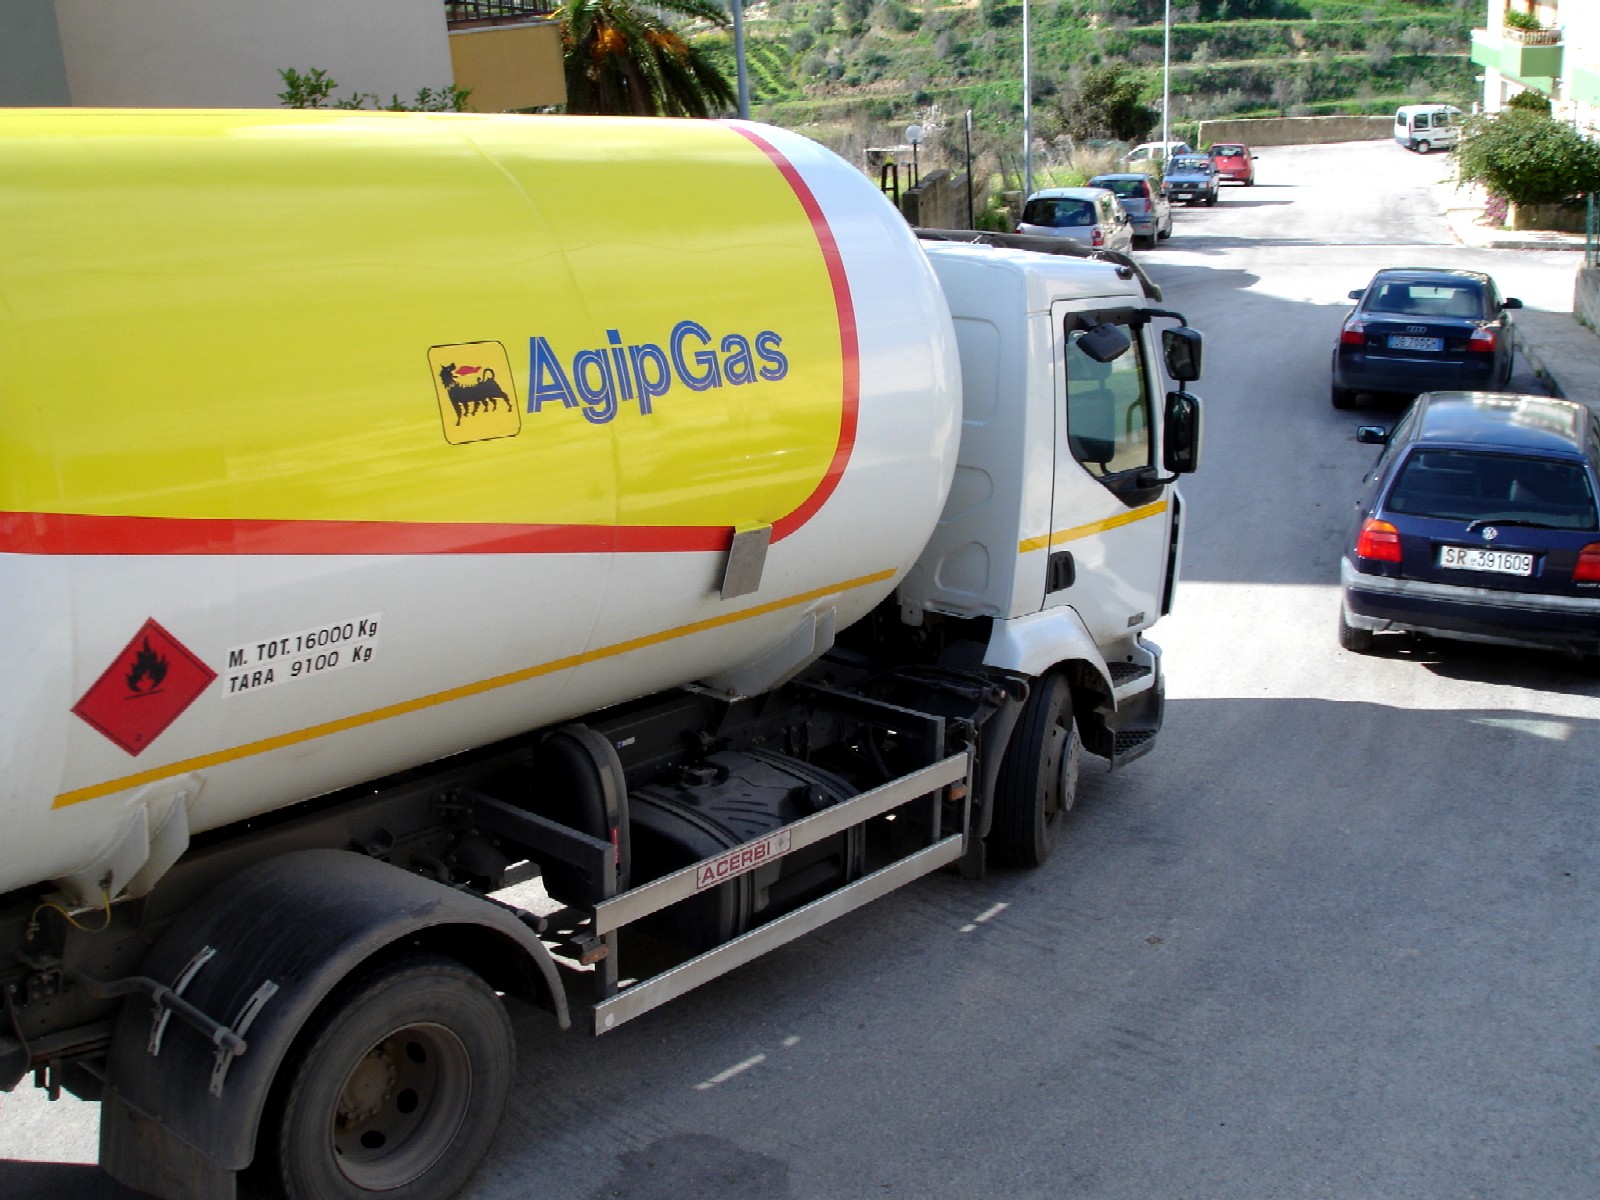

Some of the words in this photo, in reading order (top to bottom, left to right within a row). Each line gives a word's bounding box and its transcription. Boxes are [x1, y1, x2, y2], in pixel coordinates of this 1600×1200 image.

[527, 320, 788, 424] AgipGas
[229, 649, 247, 668] M.
[358, 619, 378, 638] Kg
[230, 668, 274, 693] TARA
[290, 651, 339, 677] 9100
[352, 645, 373, 663] Kg
[702, 841, 770, 885] ACERBI
